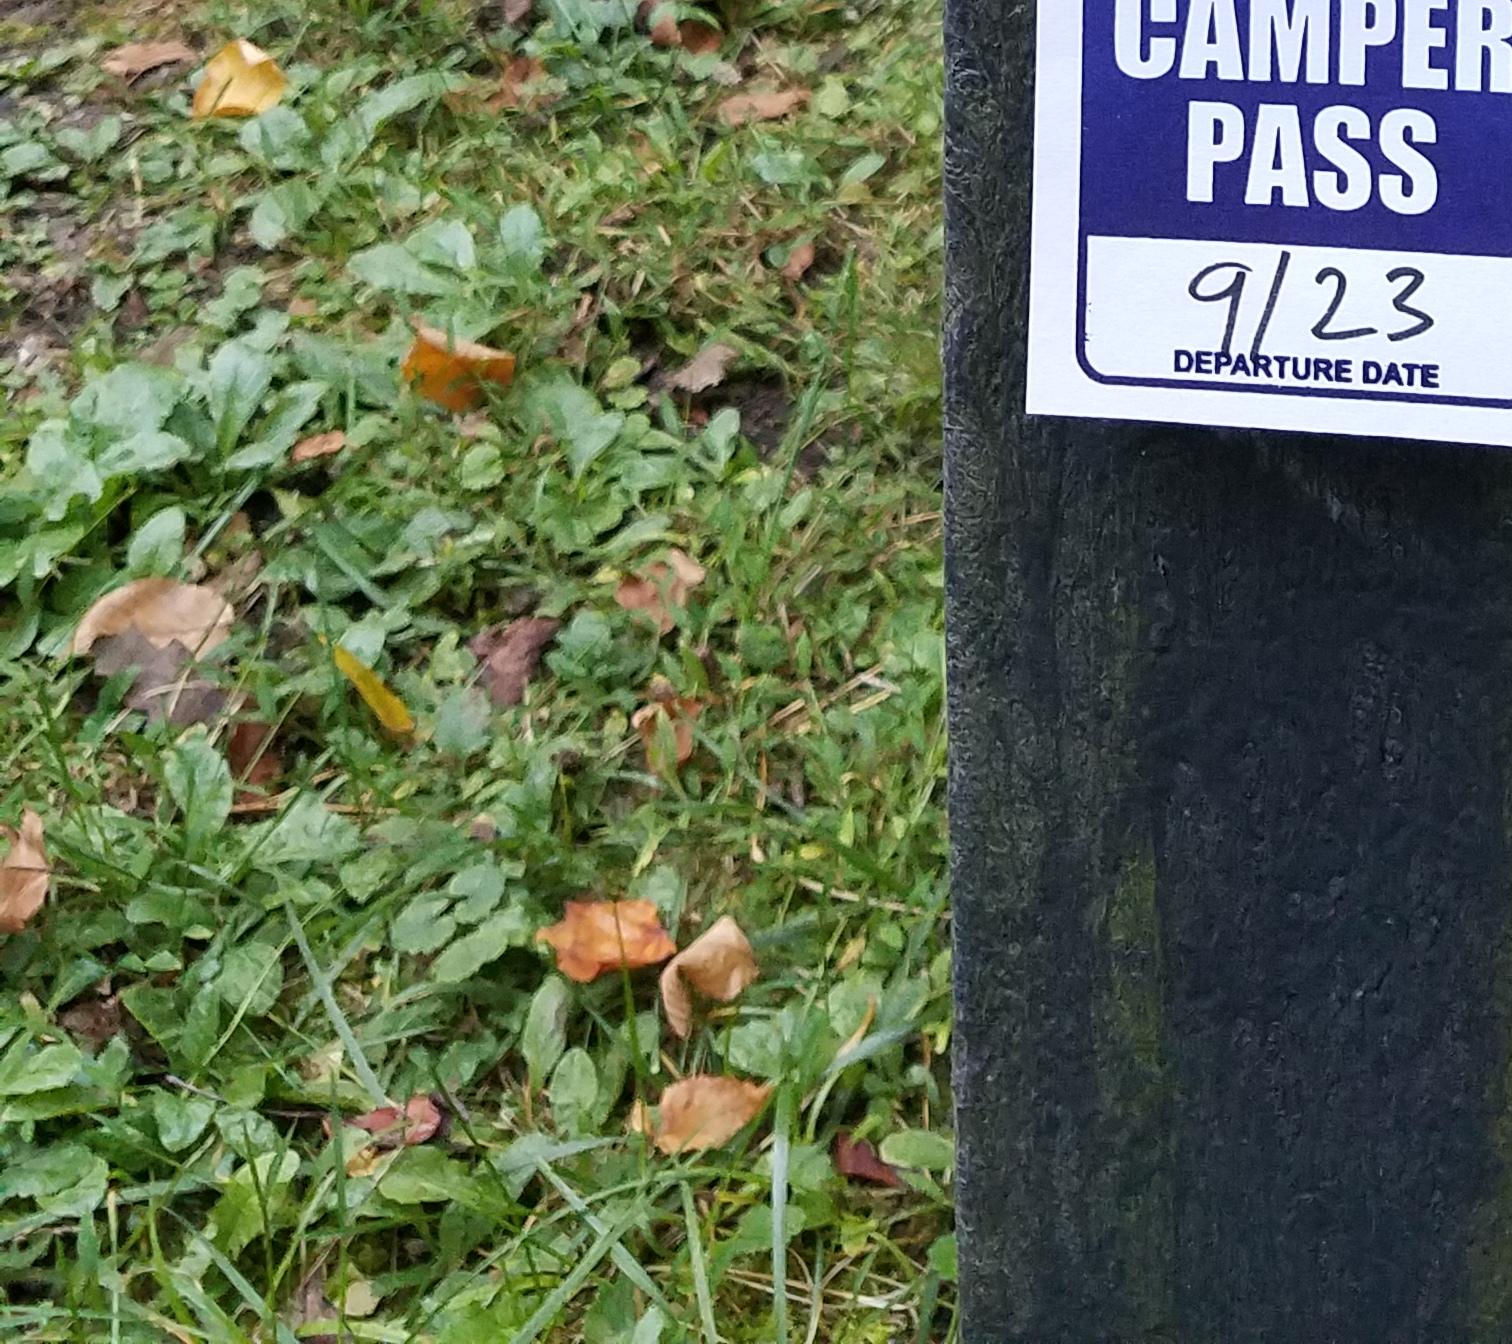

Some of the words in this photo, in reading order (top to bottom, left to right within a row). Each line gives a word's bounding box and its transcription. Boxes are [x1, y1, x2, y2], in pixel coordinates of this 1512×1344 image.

[1185, 100, 1438, 215] PASS
[1187, 249, 1435, 360] 9/23
[1173, 347, 1353, 384] DEPARTURE
[1362, 358, 1441, 389] DATE
